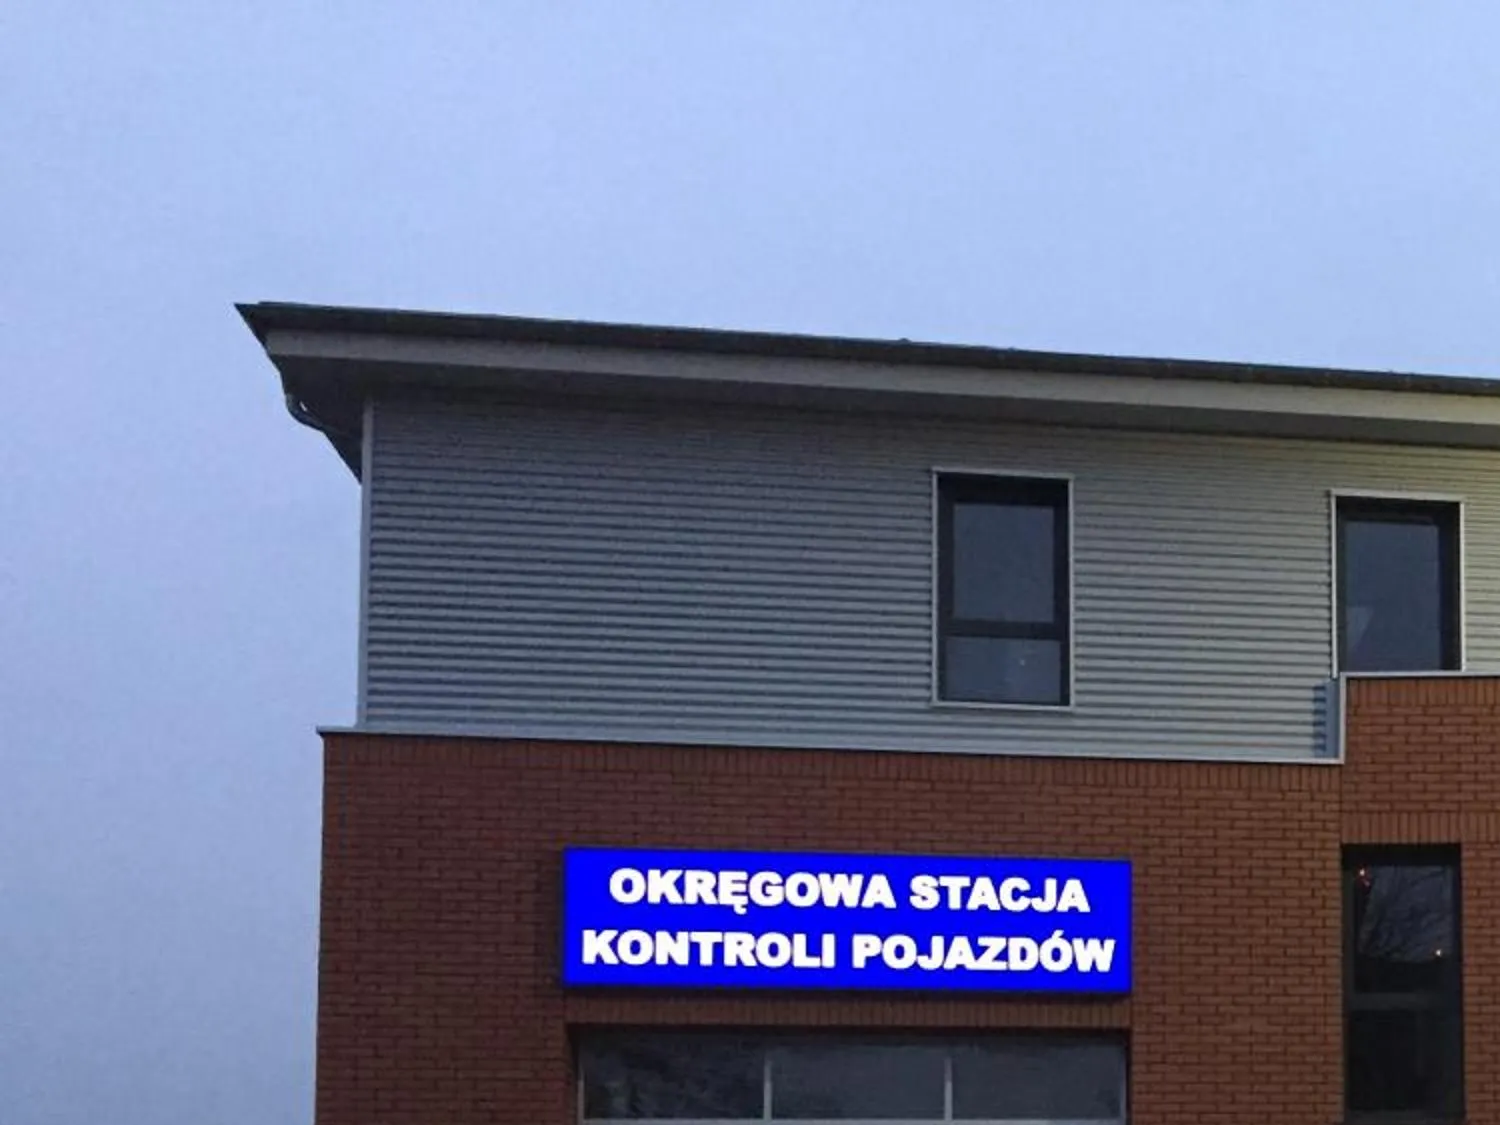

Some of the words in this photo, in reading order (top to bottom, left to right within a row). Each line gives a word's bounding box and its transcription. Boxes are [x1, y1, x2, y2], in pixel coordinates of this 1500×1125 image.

[608, 867, 897, 915] OKRĘGOWA
[909, 874, 1091, 913] STACJA
[581, 929, 836, 969] KONTROLI
[852, 929, 1117, 973] POJAZDÓW
